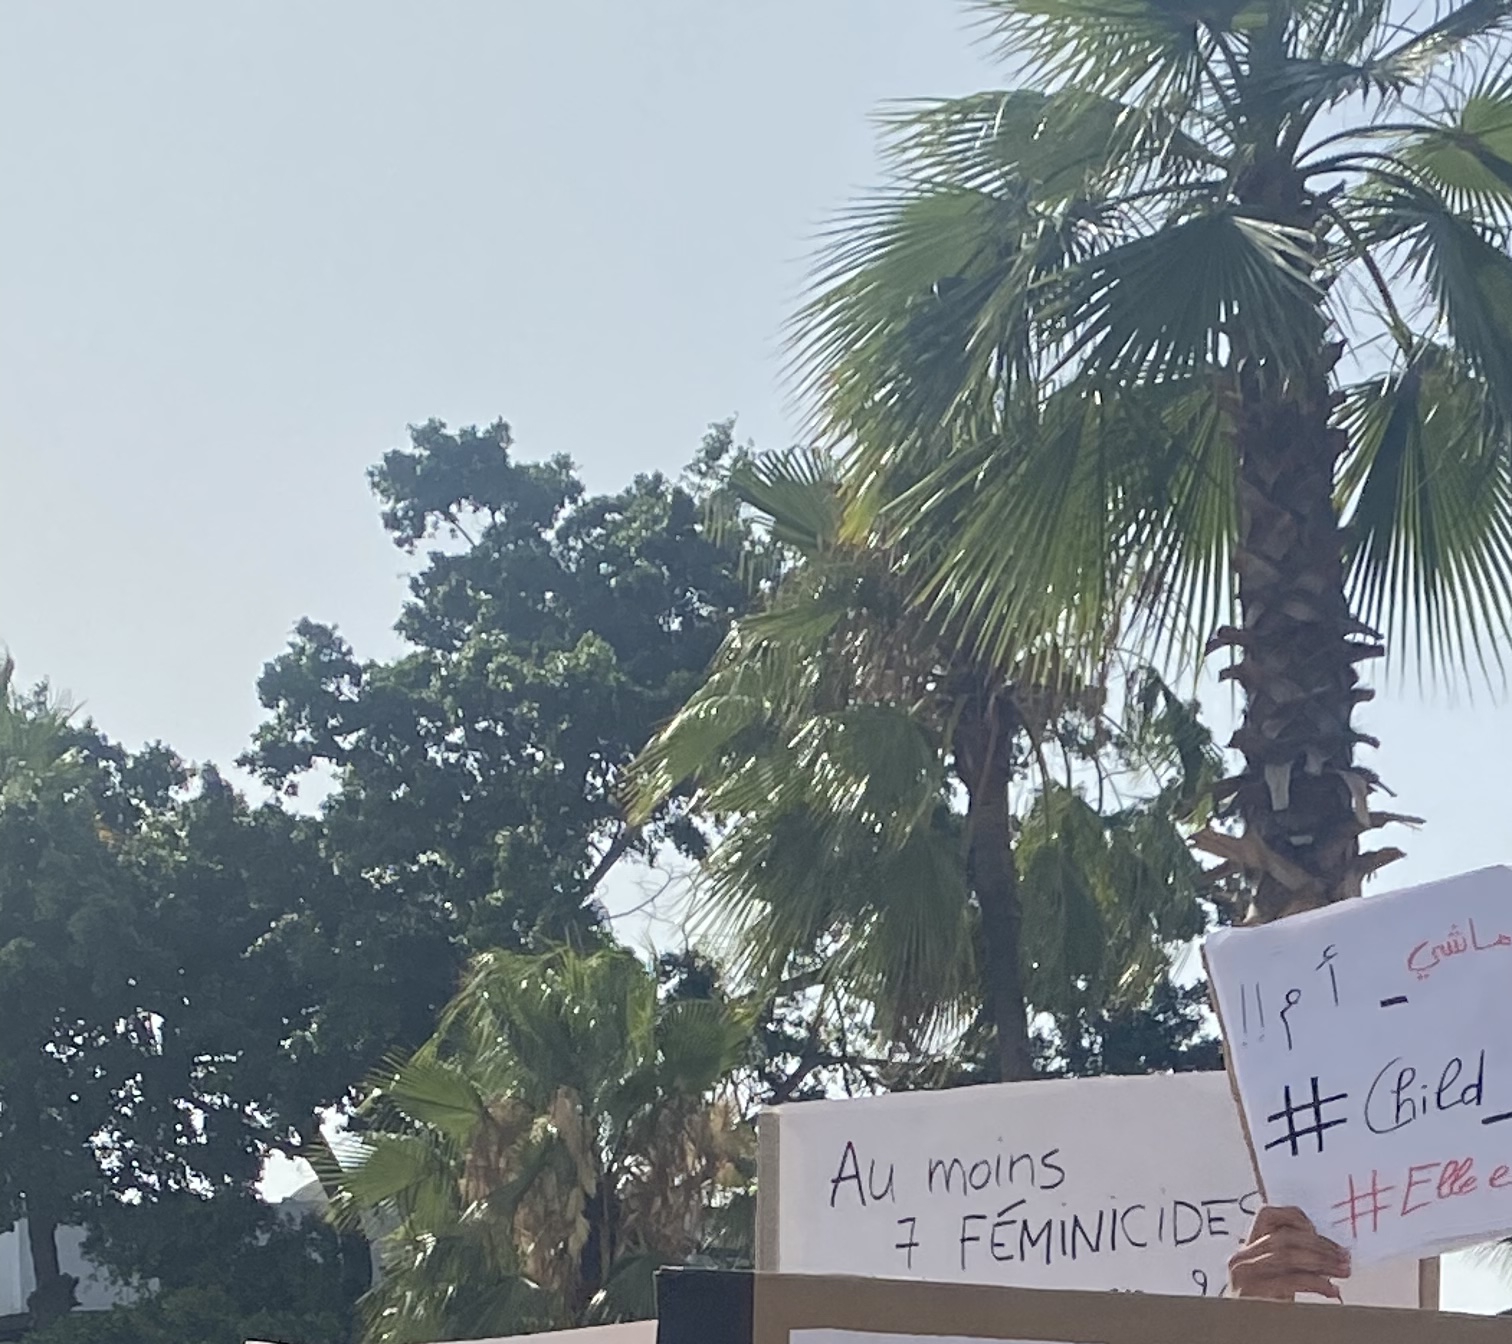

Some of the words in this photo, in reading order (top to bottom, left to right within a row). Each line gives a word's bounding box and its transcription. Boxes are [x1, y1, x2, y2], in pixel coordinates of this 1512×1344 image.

[830, 1141, 895, 1207] Au
[928, 1147, 1065, 1193] moins
[896, 1218, 920, 1269] 7
